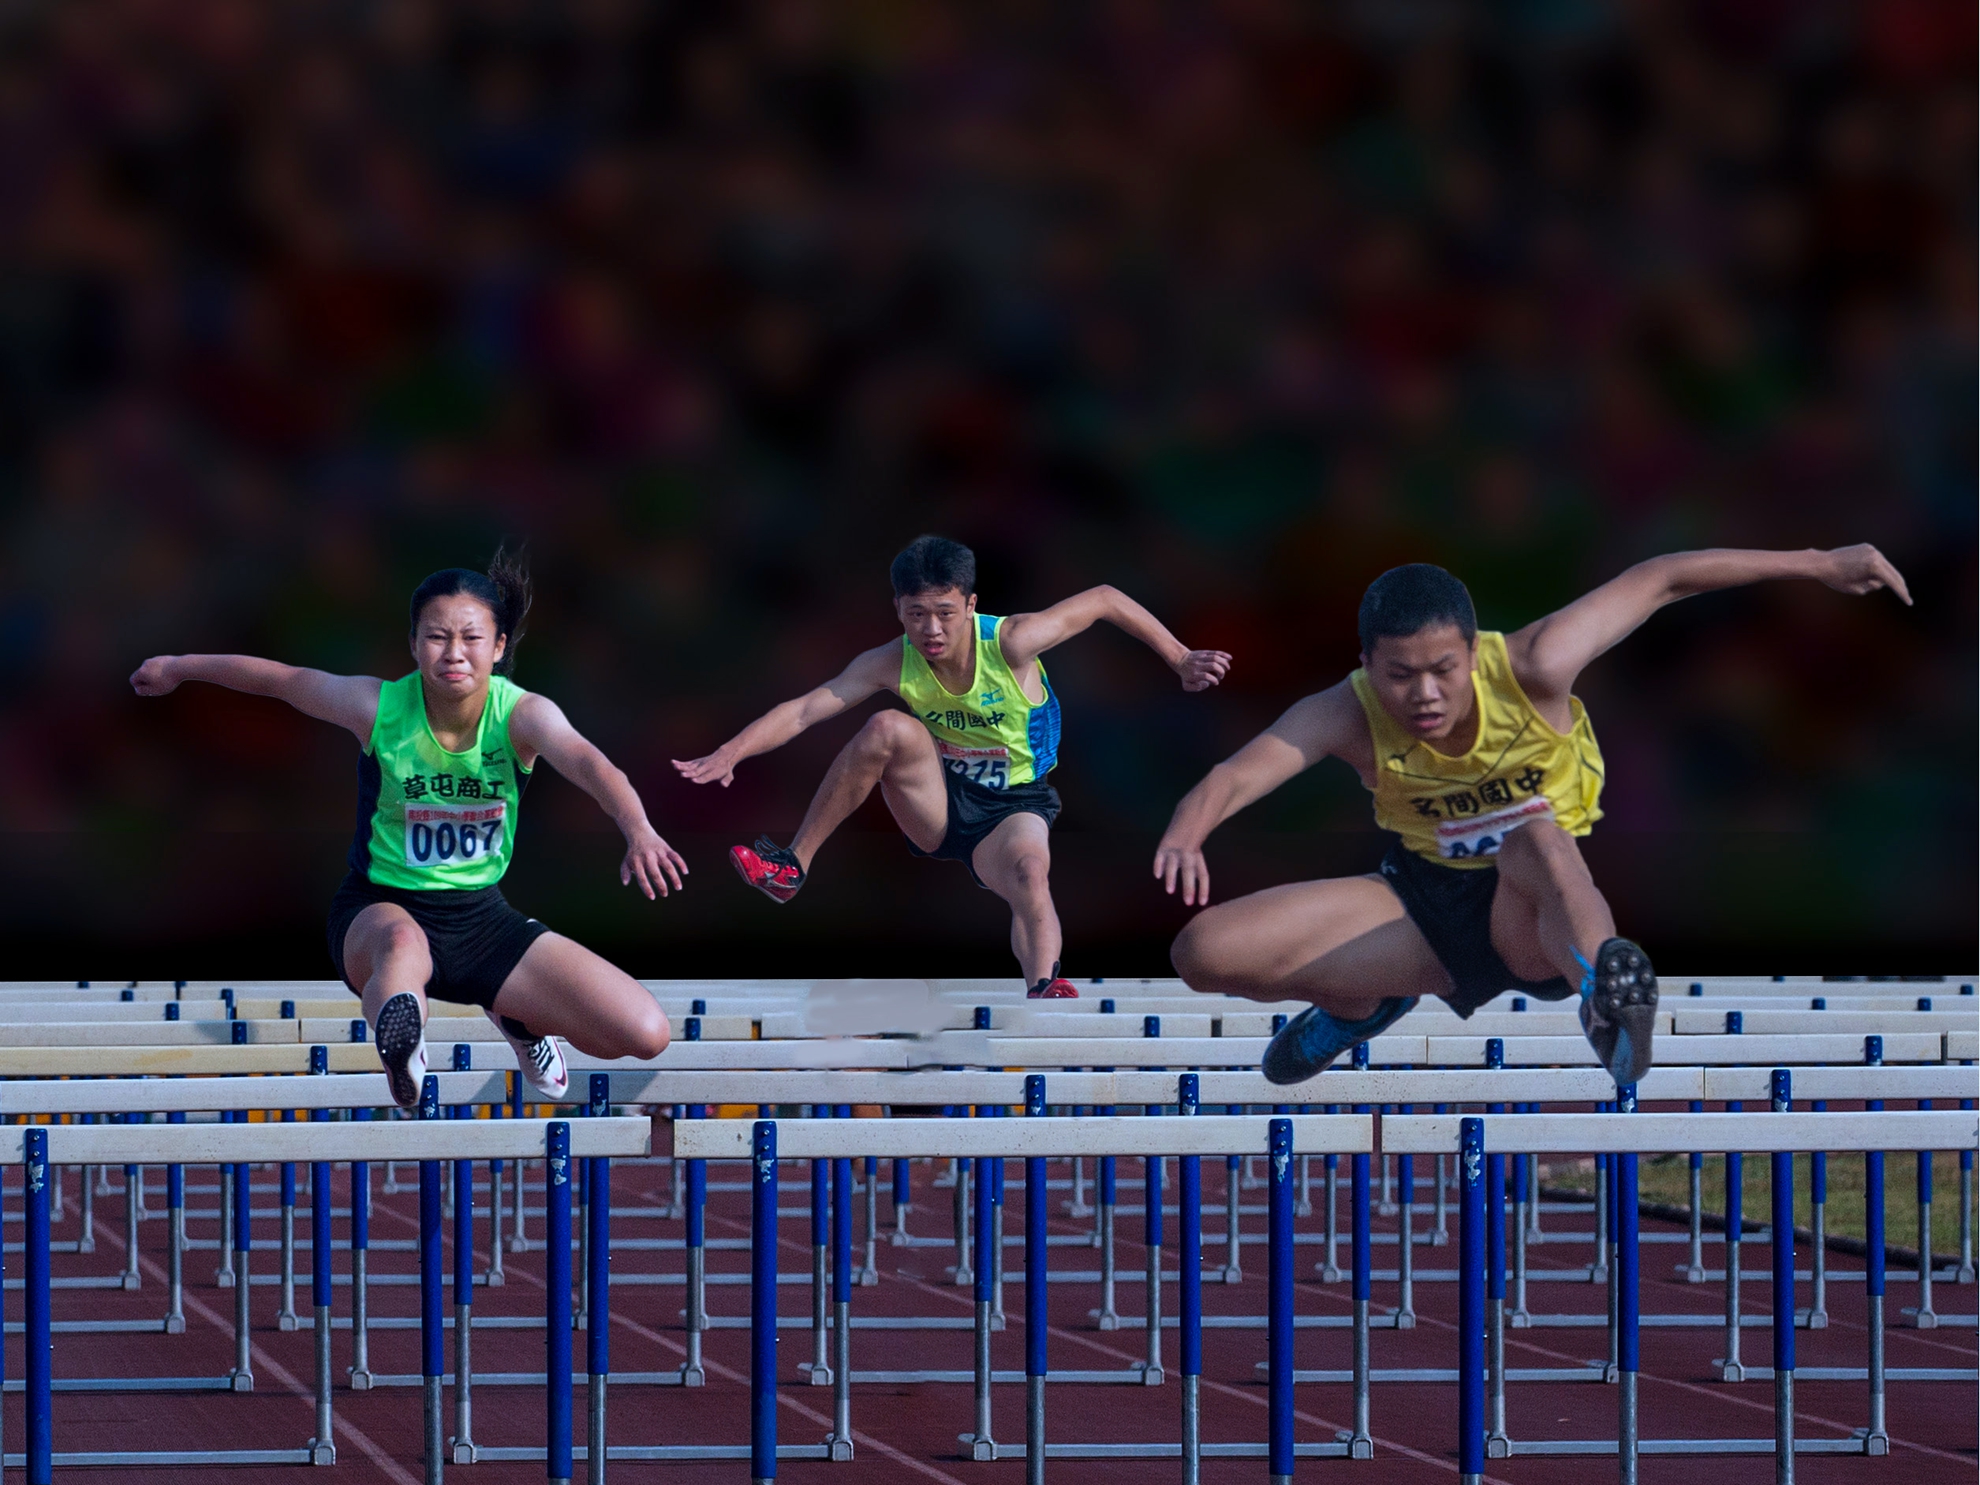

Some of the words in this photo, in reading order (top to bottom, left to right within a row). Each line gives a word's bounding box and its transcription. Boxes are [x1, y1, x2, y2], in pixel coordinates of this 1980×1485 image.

[402, 772, 506, 800] 草屯商工
[412, 820, 502, 862] 0067
